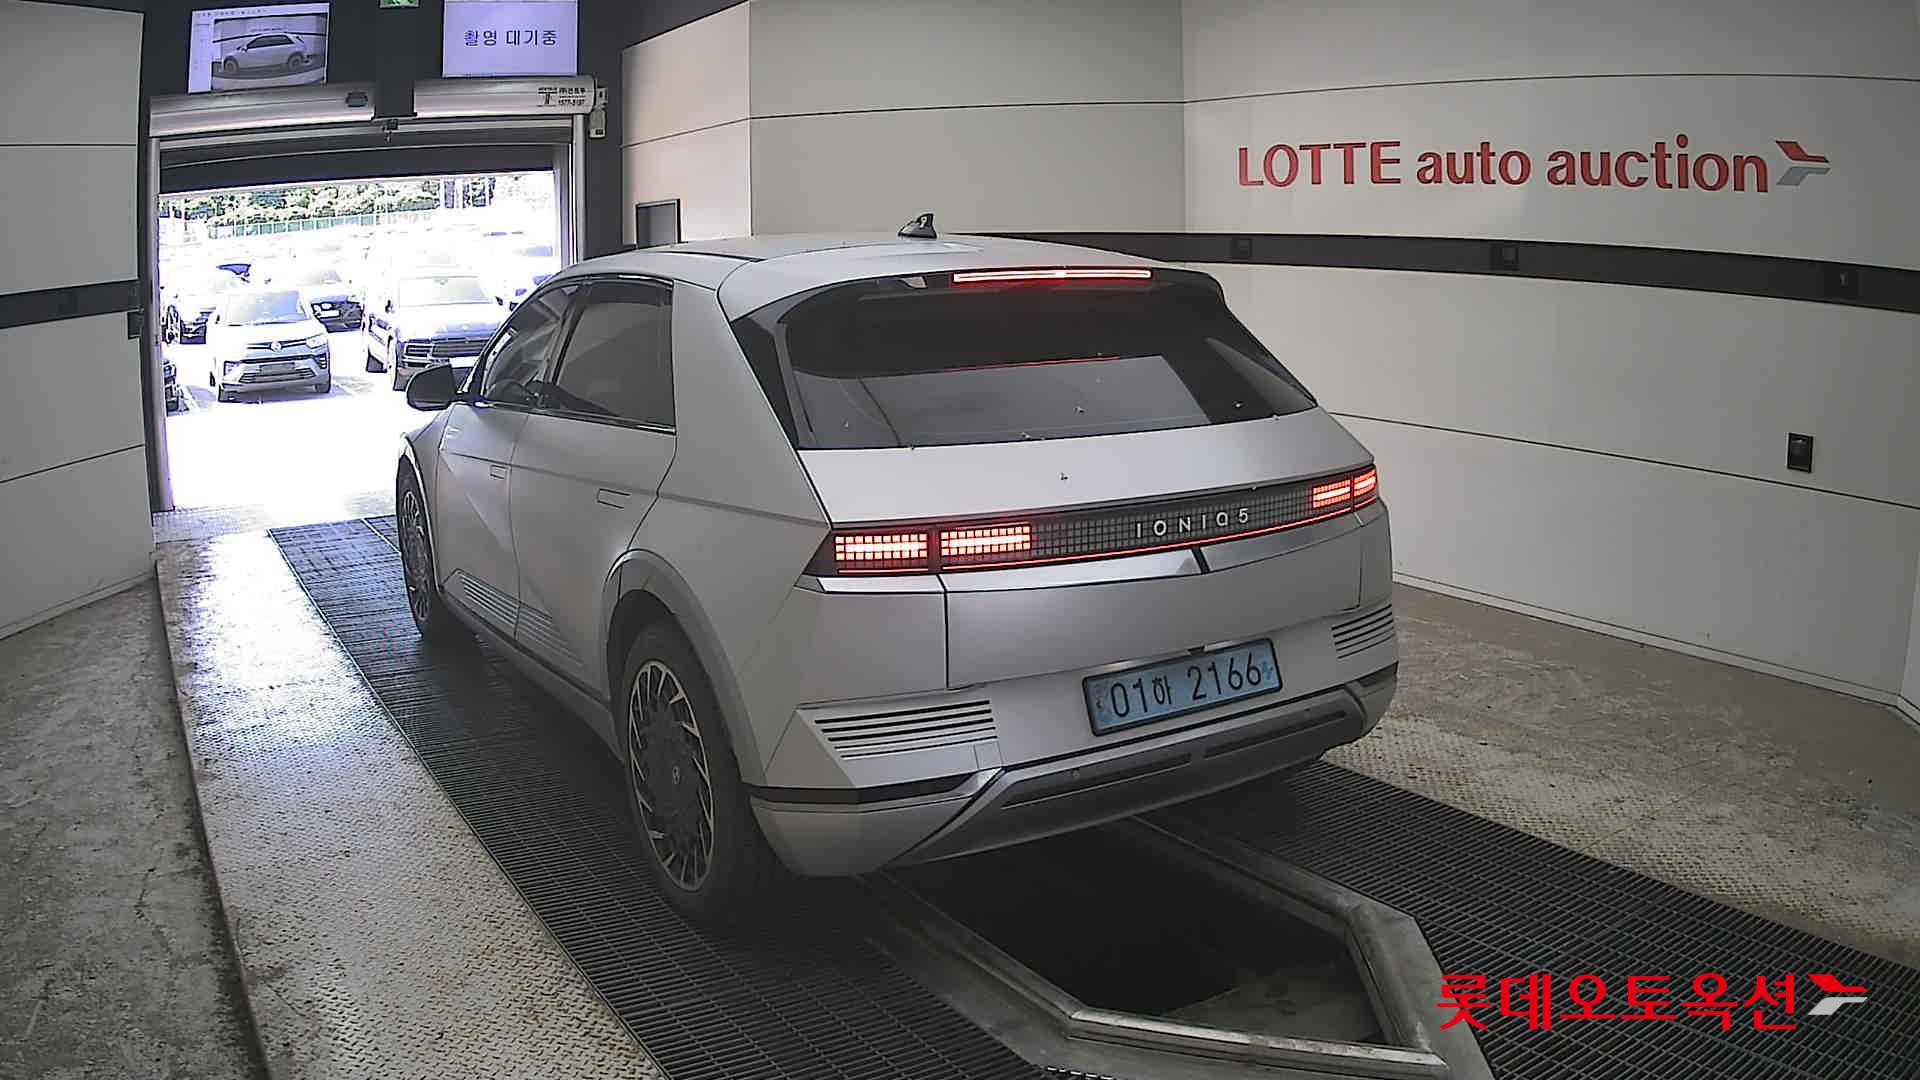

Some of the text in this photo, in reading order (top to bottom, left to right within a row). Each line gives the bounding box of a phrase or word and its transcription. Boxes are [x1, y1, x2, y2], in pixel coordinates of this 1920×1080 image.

[505, 30, 557, 46] 대기중
[1239, 133, 1769, 193] LOTTE auto auction
[1238, 508, 1249, 523] 5
[1110, 652, 1262, 718] 01하 2166
